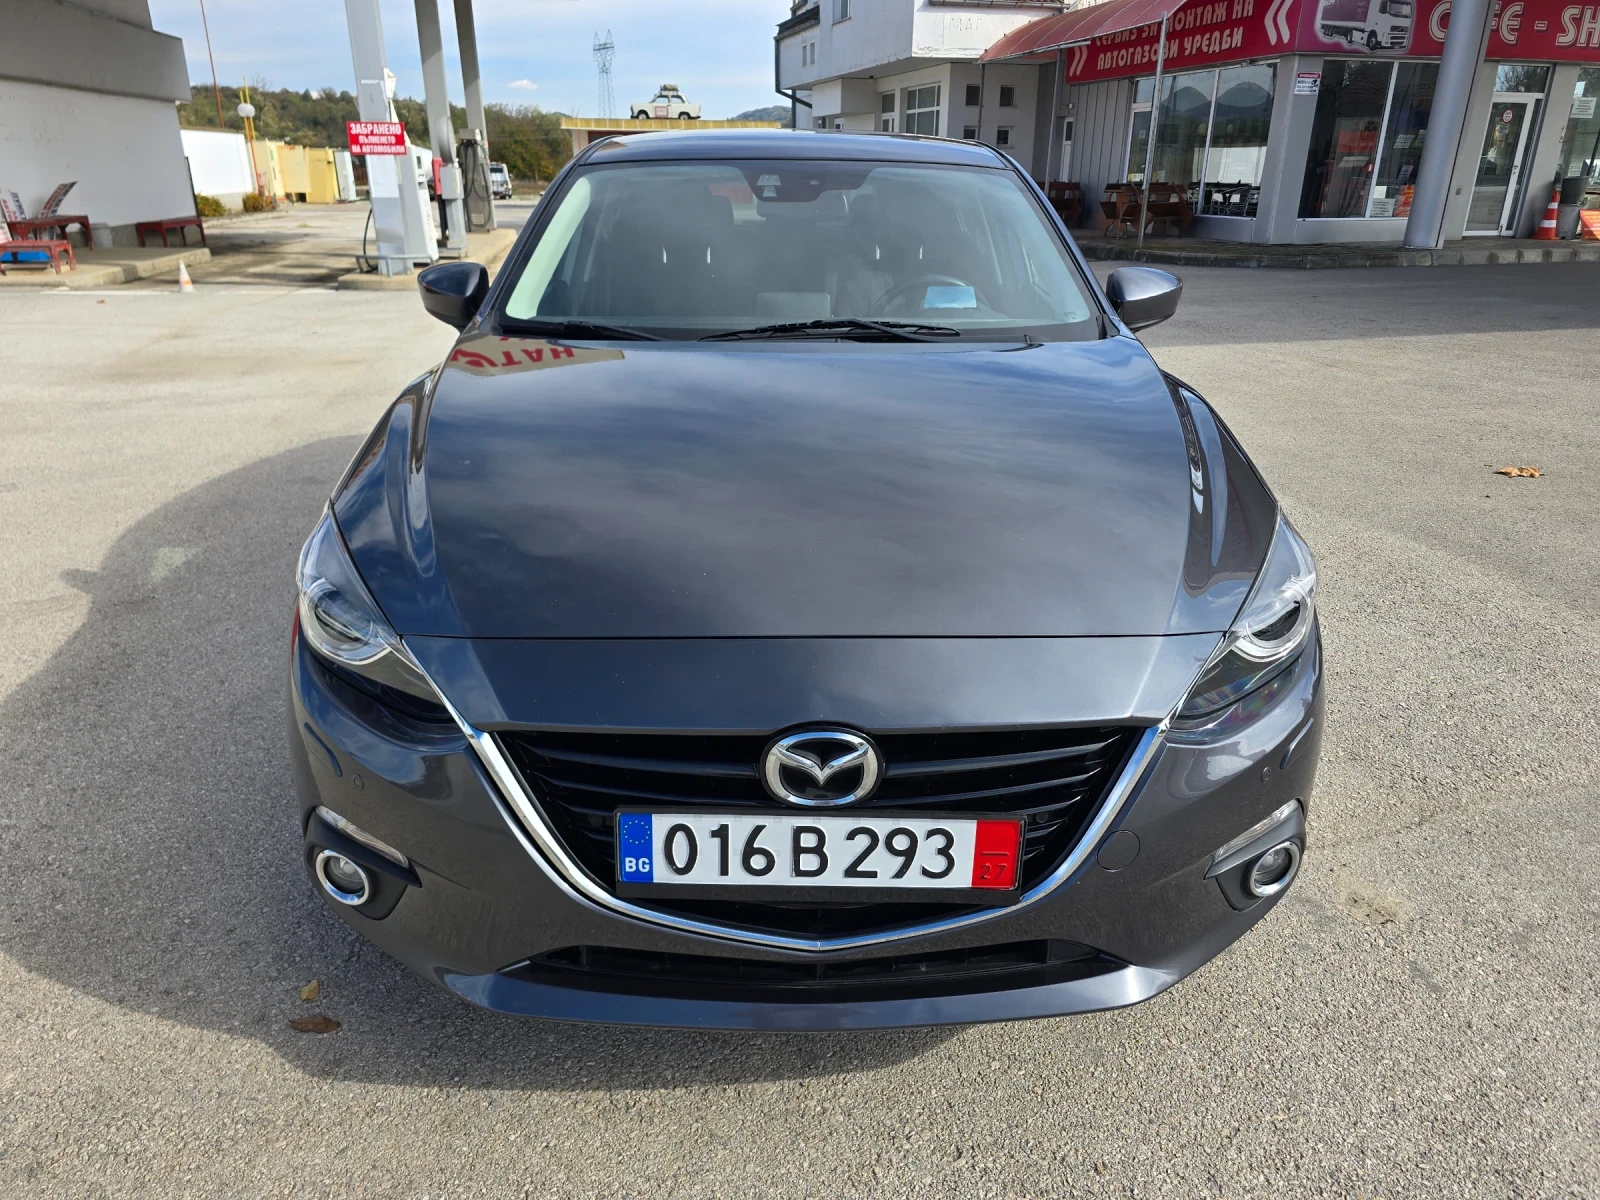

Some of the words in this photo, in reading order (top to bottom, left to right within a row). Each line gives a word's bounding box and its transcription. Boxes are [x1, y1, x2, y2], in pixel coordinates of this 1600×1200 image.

[1232, 0, 1255, 20] НА
[1097, 38, 1180, 71] АВТОГАЗОВИ
[1183, 26, 1244, 57] УРЕДБИ
[350, 122, 402, 135] ЗАБРАНЕНО
[358, 135, 396, 144] ПЪЛНЕНЕТО
[351, 144, 361, 153] НА
[362, 144, 406, 153] АВТОМОБИЛИ
[625, 857, 650, 872] BG
[980, 863, 1007, 879] 27
